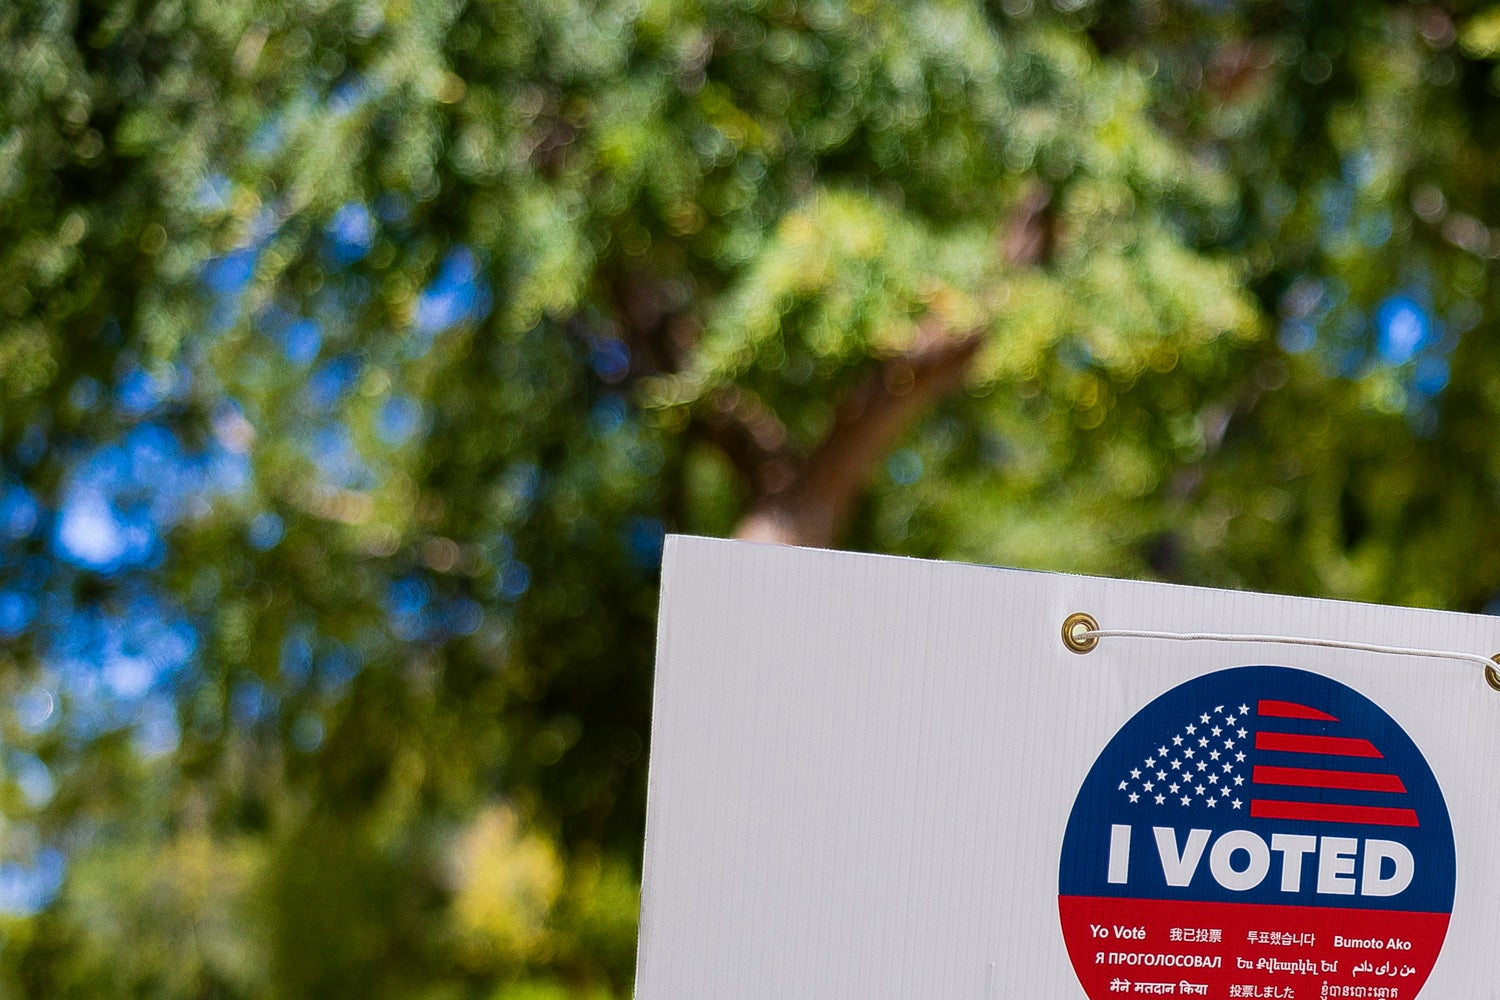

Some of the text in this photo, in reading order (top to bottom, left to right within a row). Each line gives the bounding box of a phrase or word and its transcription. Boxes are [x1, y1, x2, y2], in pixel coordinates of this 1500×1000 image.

[1107, 824, 1416, 898] I VOTED
[1089, 924, 1147, 940] Yo Voté
[1169, 927, 1223, 943] 我已投票
[1246, 930, 1316, 947] 투표했습니다
[1333, 935, 1412, 951] Bumoto Ako
[1095, 951, 1222, 968] Я ПРОГОЛОСОВАЛ
[1236, 956, 1339, 976] Ես Քվեարկել Եմ
[1352, 960, 1373, 978] دادم
[1400, 964, 1416, 977] من
[1134, 982, 1177, 995] मतदान
[1178, 979, 1209, 996] किया
[1229, 984, 1295, 999] 投票しました
